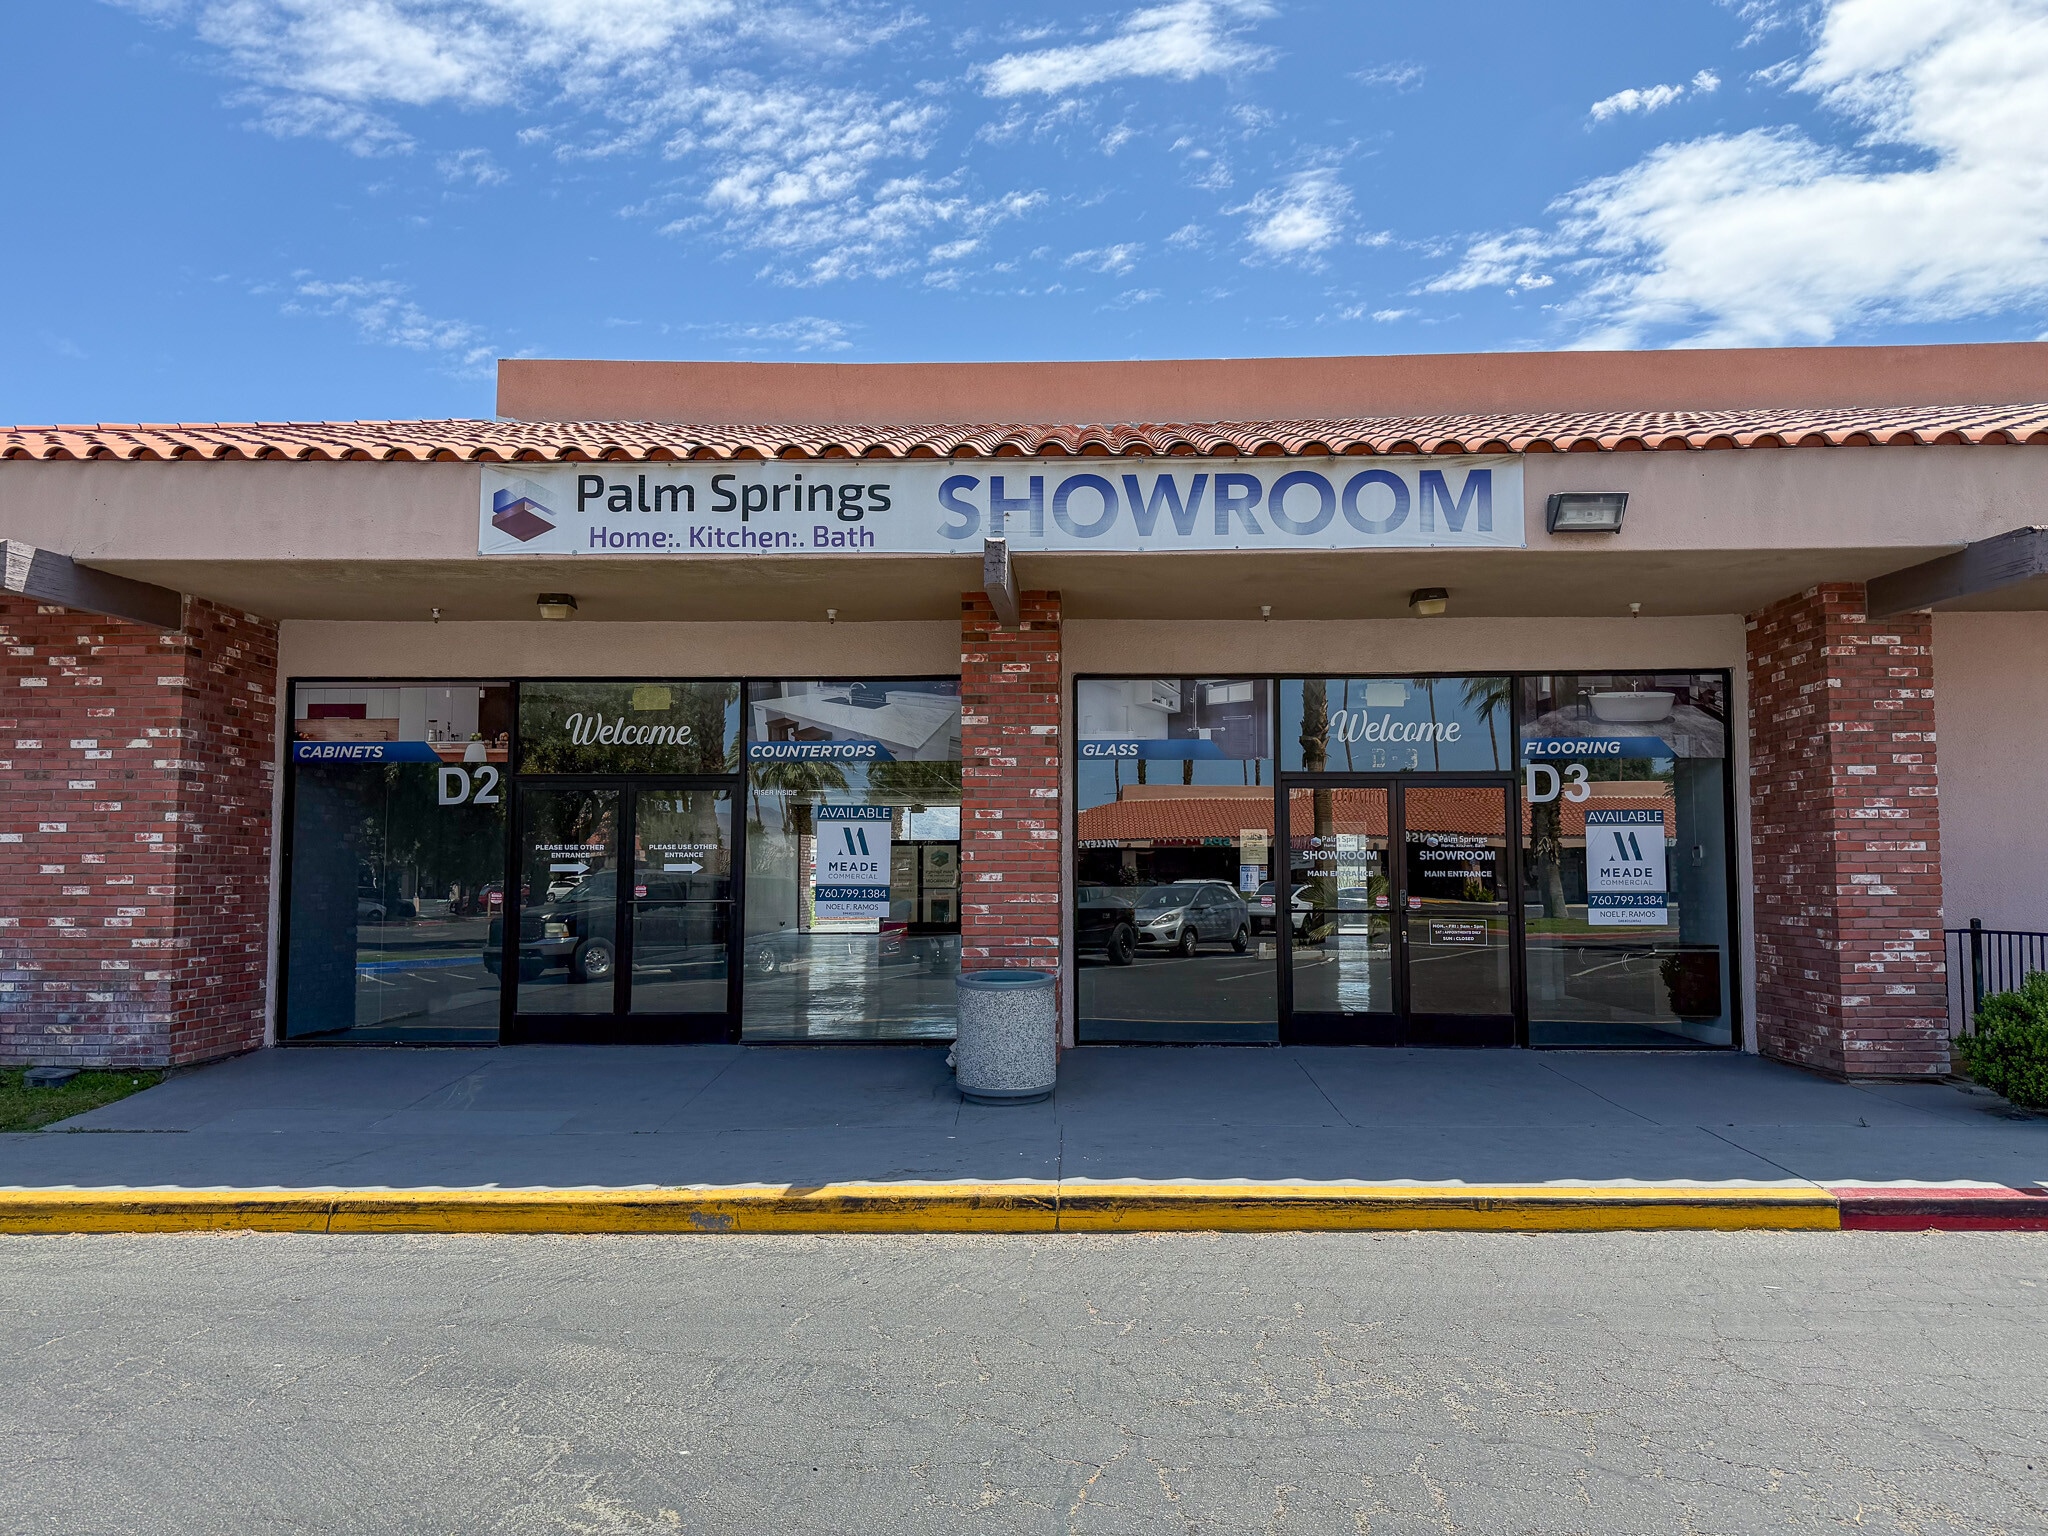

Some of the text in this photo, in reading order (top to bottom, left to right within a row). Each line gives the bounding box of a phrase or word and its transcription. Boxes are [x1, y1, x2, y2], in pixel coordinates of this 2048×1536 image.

[577, 474, 891, 521] Palm Springs
[936, 468, 1493, 539] SHOWROOM
[813, 525, 875, 547] Bath
[565, 712, 693, 746] Welcome
[1330, 709, 1461, 742] Welcome
[299, 745, 384, 759] CABINETS
[750, 744, 876, 759] COUNTERTOPS
[1082, 743, 1139, 757] GLASS
[1524, 741, 1621, 755] FLOORING
[438, 765, 500, 805] D2
[1526, 763, 1591, 803] D3
[819, 807, 890, 819] AVAILABLE
[1587, 811, 1662, 823] AVAILABLE
[1459, 835, 1488, 844] Springs
[1302, 850, 1378, 860] SHOWROOM
[1419, 850, 1496, 861] SHOWROOM
[828, 861, 879, 872] MEADE
[1600, 867, 1653, 878] MEADE
[1424, 870, 1492, 878] MAIN ENTRANCE
[819, 888, 887, 899] 760.799.1384
[1591, 895, 1664, 906] 760.799.1384
[825, 903, 879, 911] NOEL F. RAMOS
[1600, 910, 1656, 918] NOEL F. RAMOS
